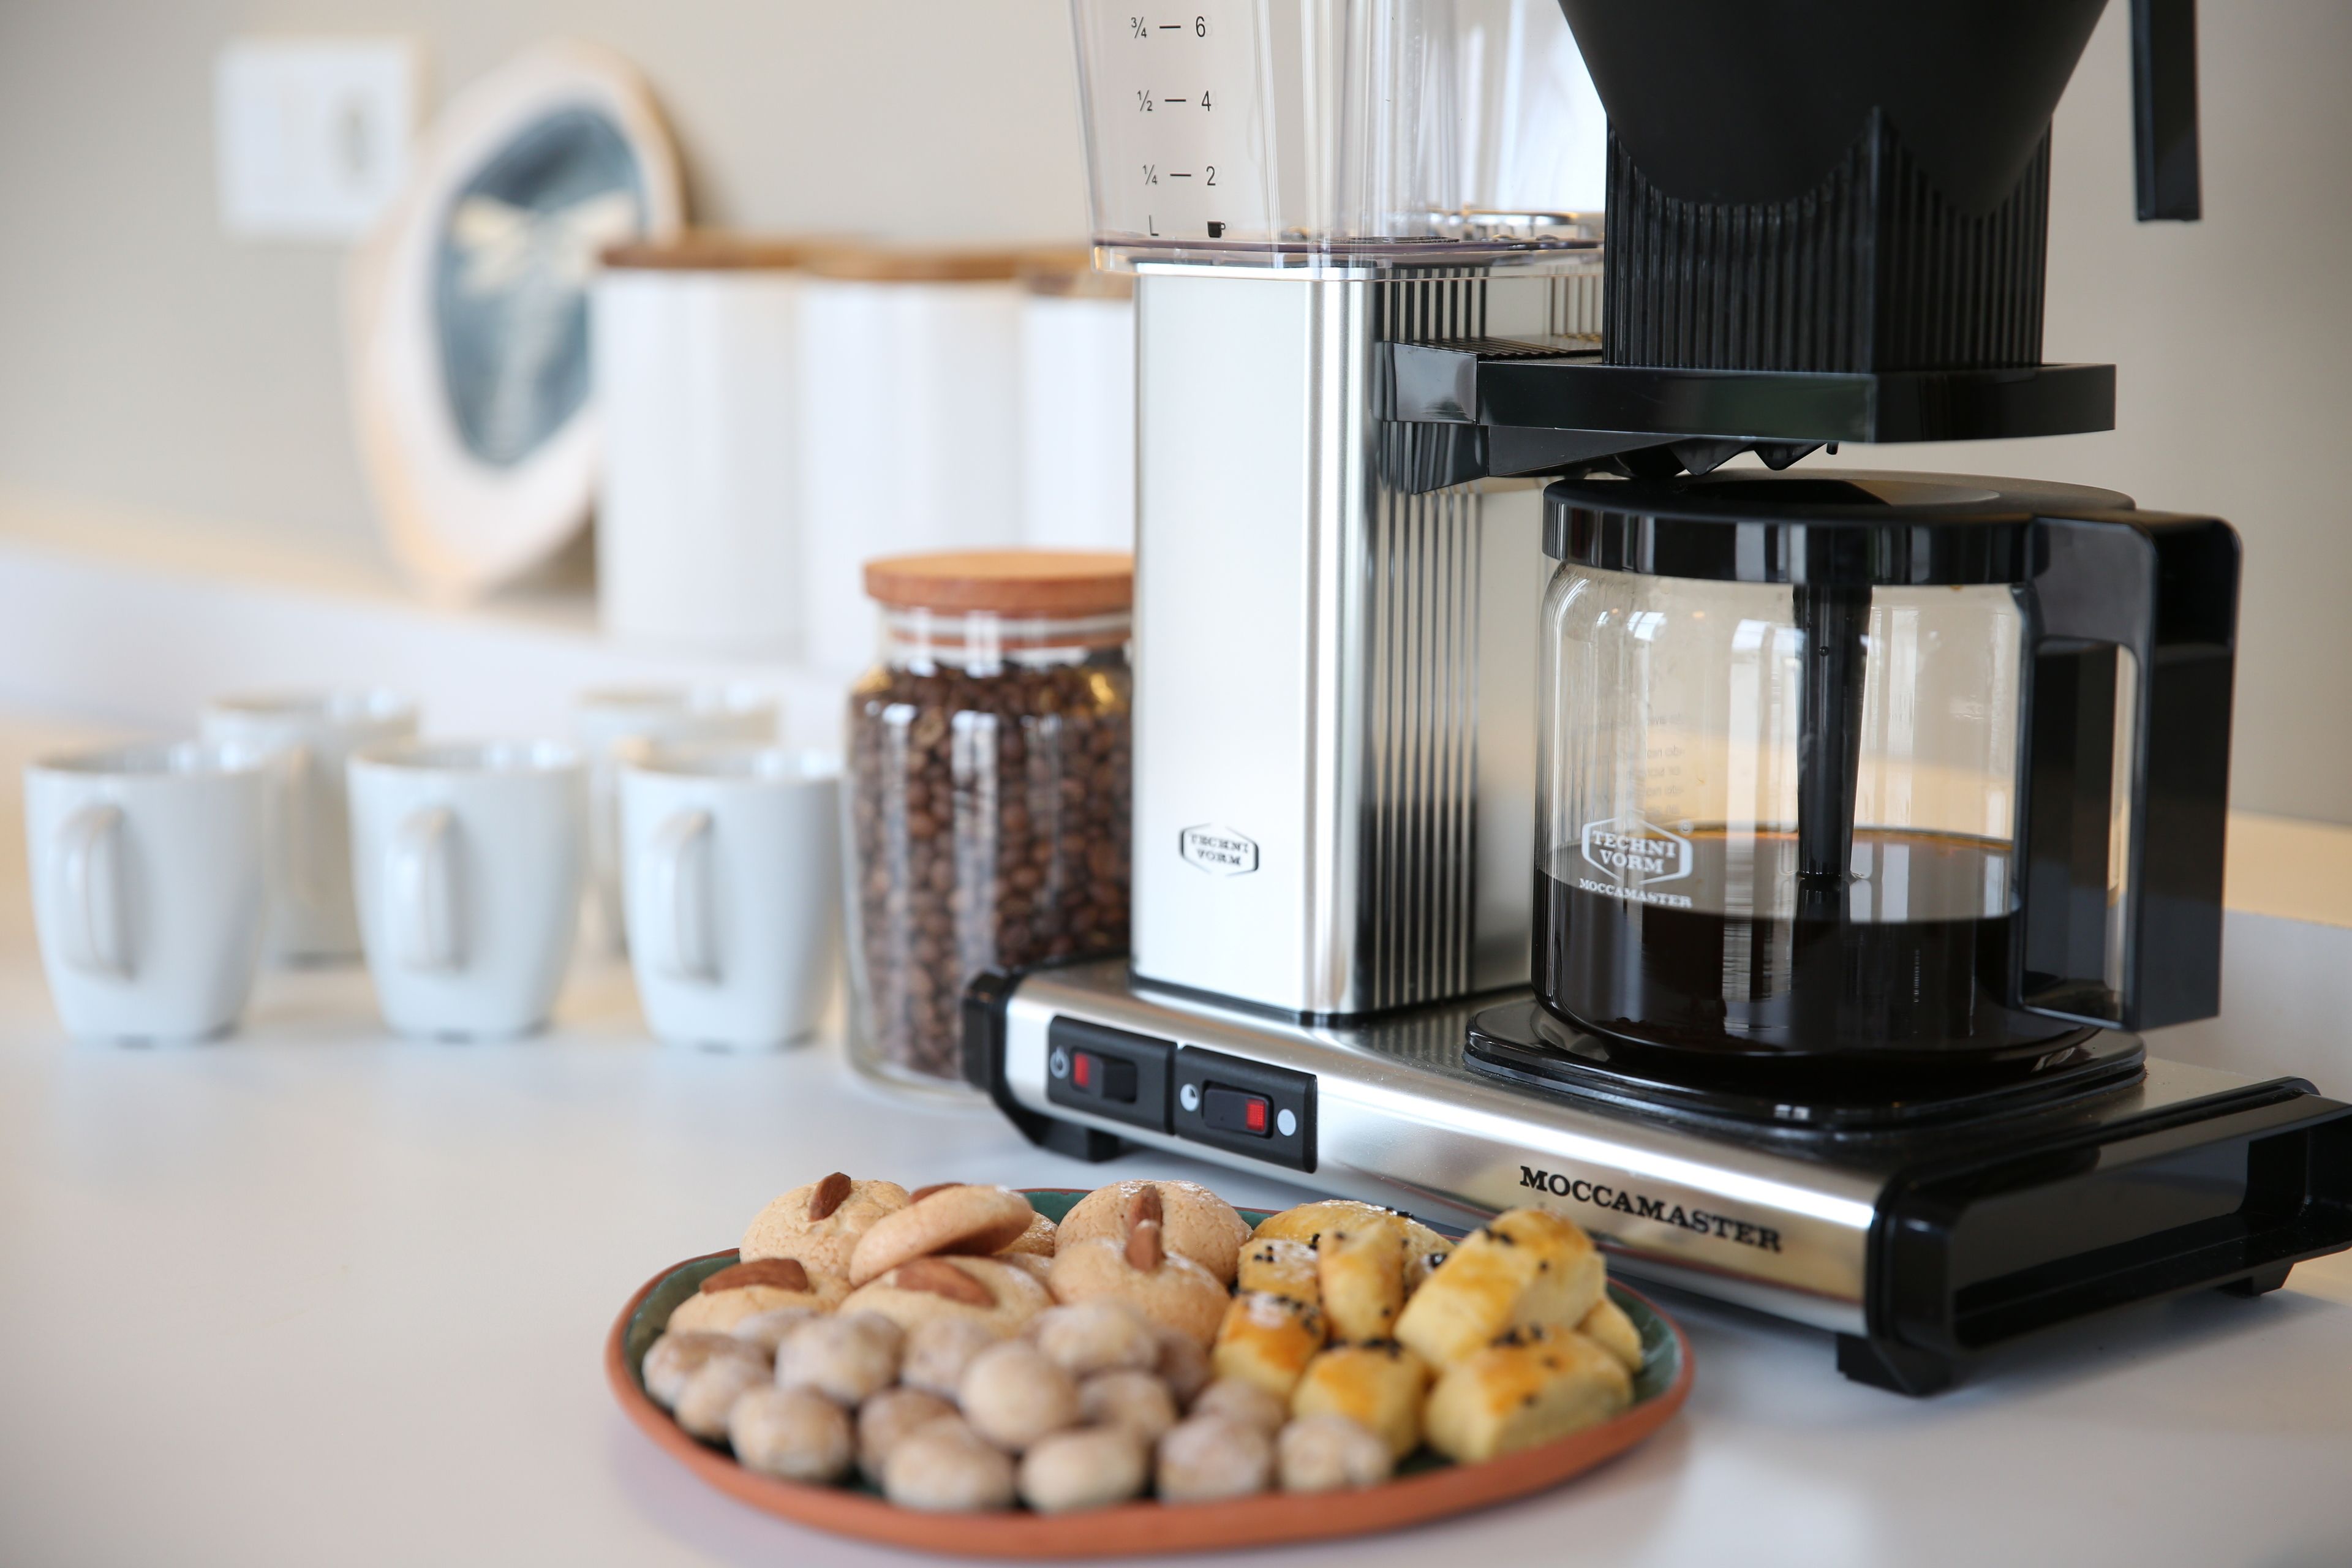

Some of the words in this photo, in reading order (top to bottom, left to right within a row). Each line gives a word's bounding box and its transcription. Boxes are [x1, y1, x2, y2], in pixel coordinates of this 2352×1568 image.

[1196, 16, 1205, 37] 6
[1201, 90, 1211, 111] 4
[1206, 165, 1216, 186] 2
[1148, 215, 1159, 236] L
[1191, 834, 1248, 853] TECHNI
[1593, 830, 1676, 858] TECHNI
[1197, 849, 1240, 865] VORM
[1600, 849, 1664, 874] VORM
[1579, 878, 1692, 908] MOCCAMASTER
[1520, 1166, 1781, 1253] MOCCAMASTER
